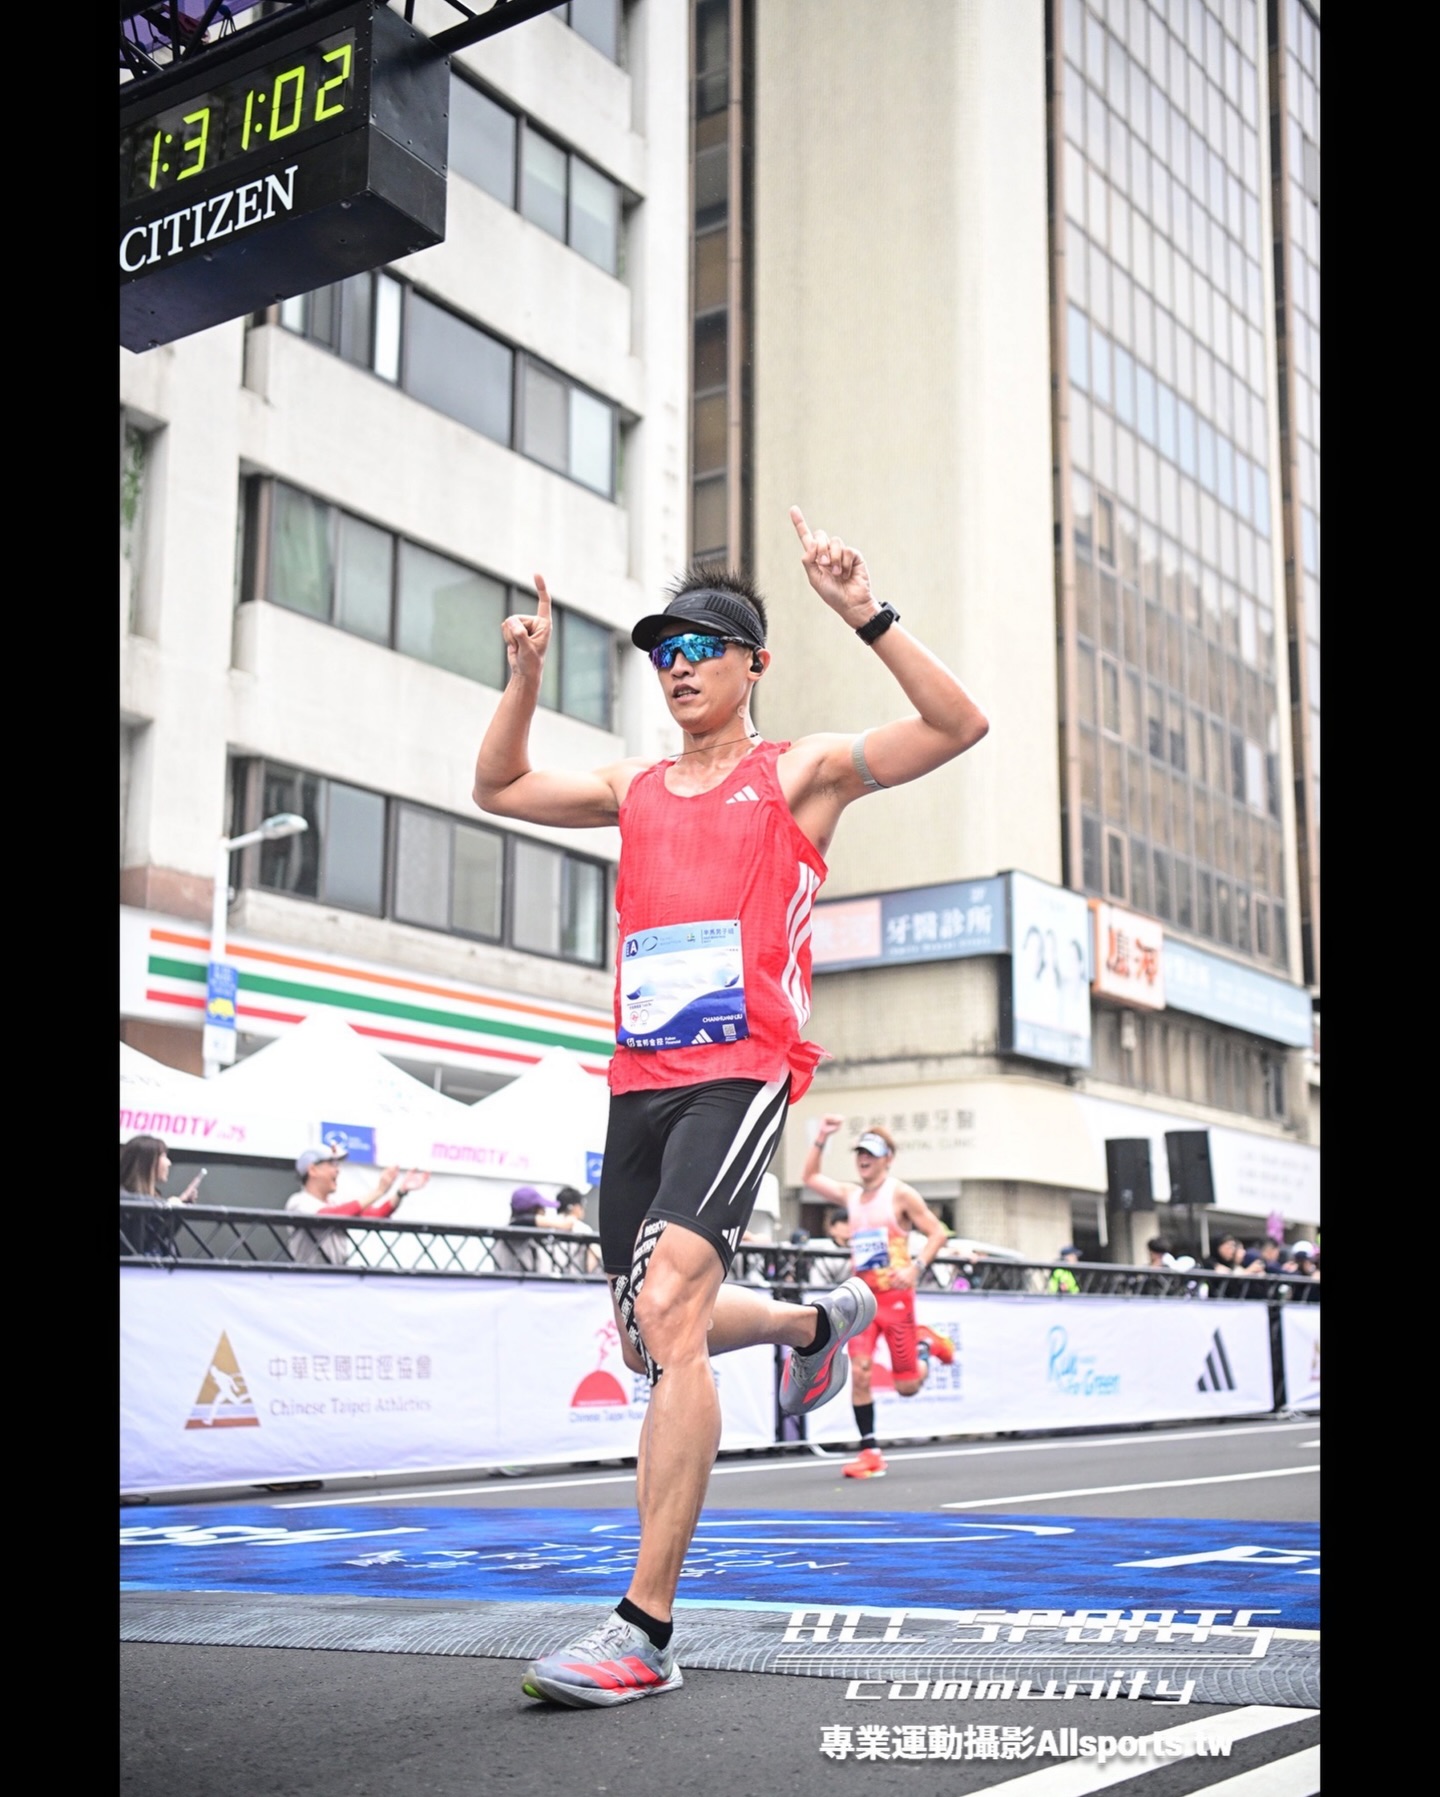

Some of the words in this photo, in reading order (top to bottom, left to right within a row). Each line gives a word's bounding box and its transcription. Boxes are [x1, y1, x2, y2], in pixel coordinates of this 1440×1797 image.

[148, 43, 352, 190] 1:31:02
[120, 166, 299, 272] CITIZEN
[269, 1399, 327, 1416] Chinese
[330, 1398, 371, 1417] Taipei
